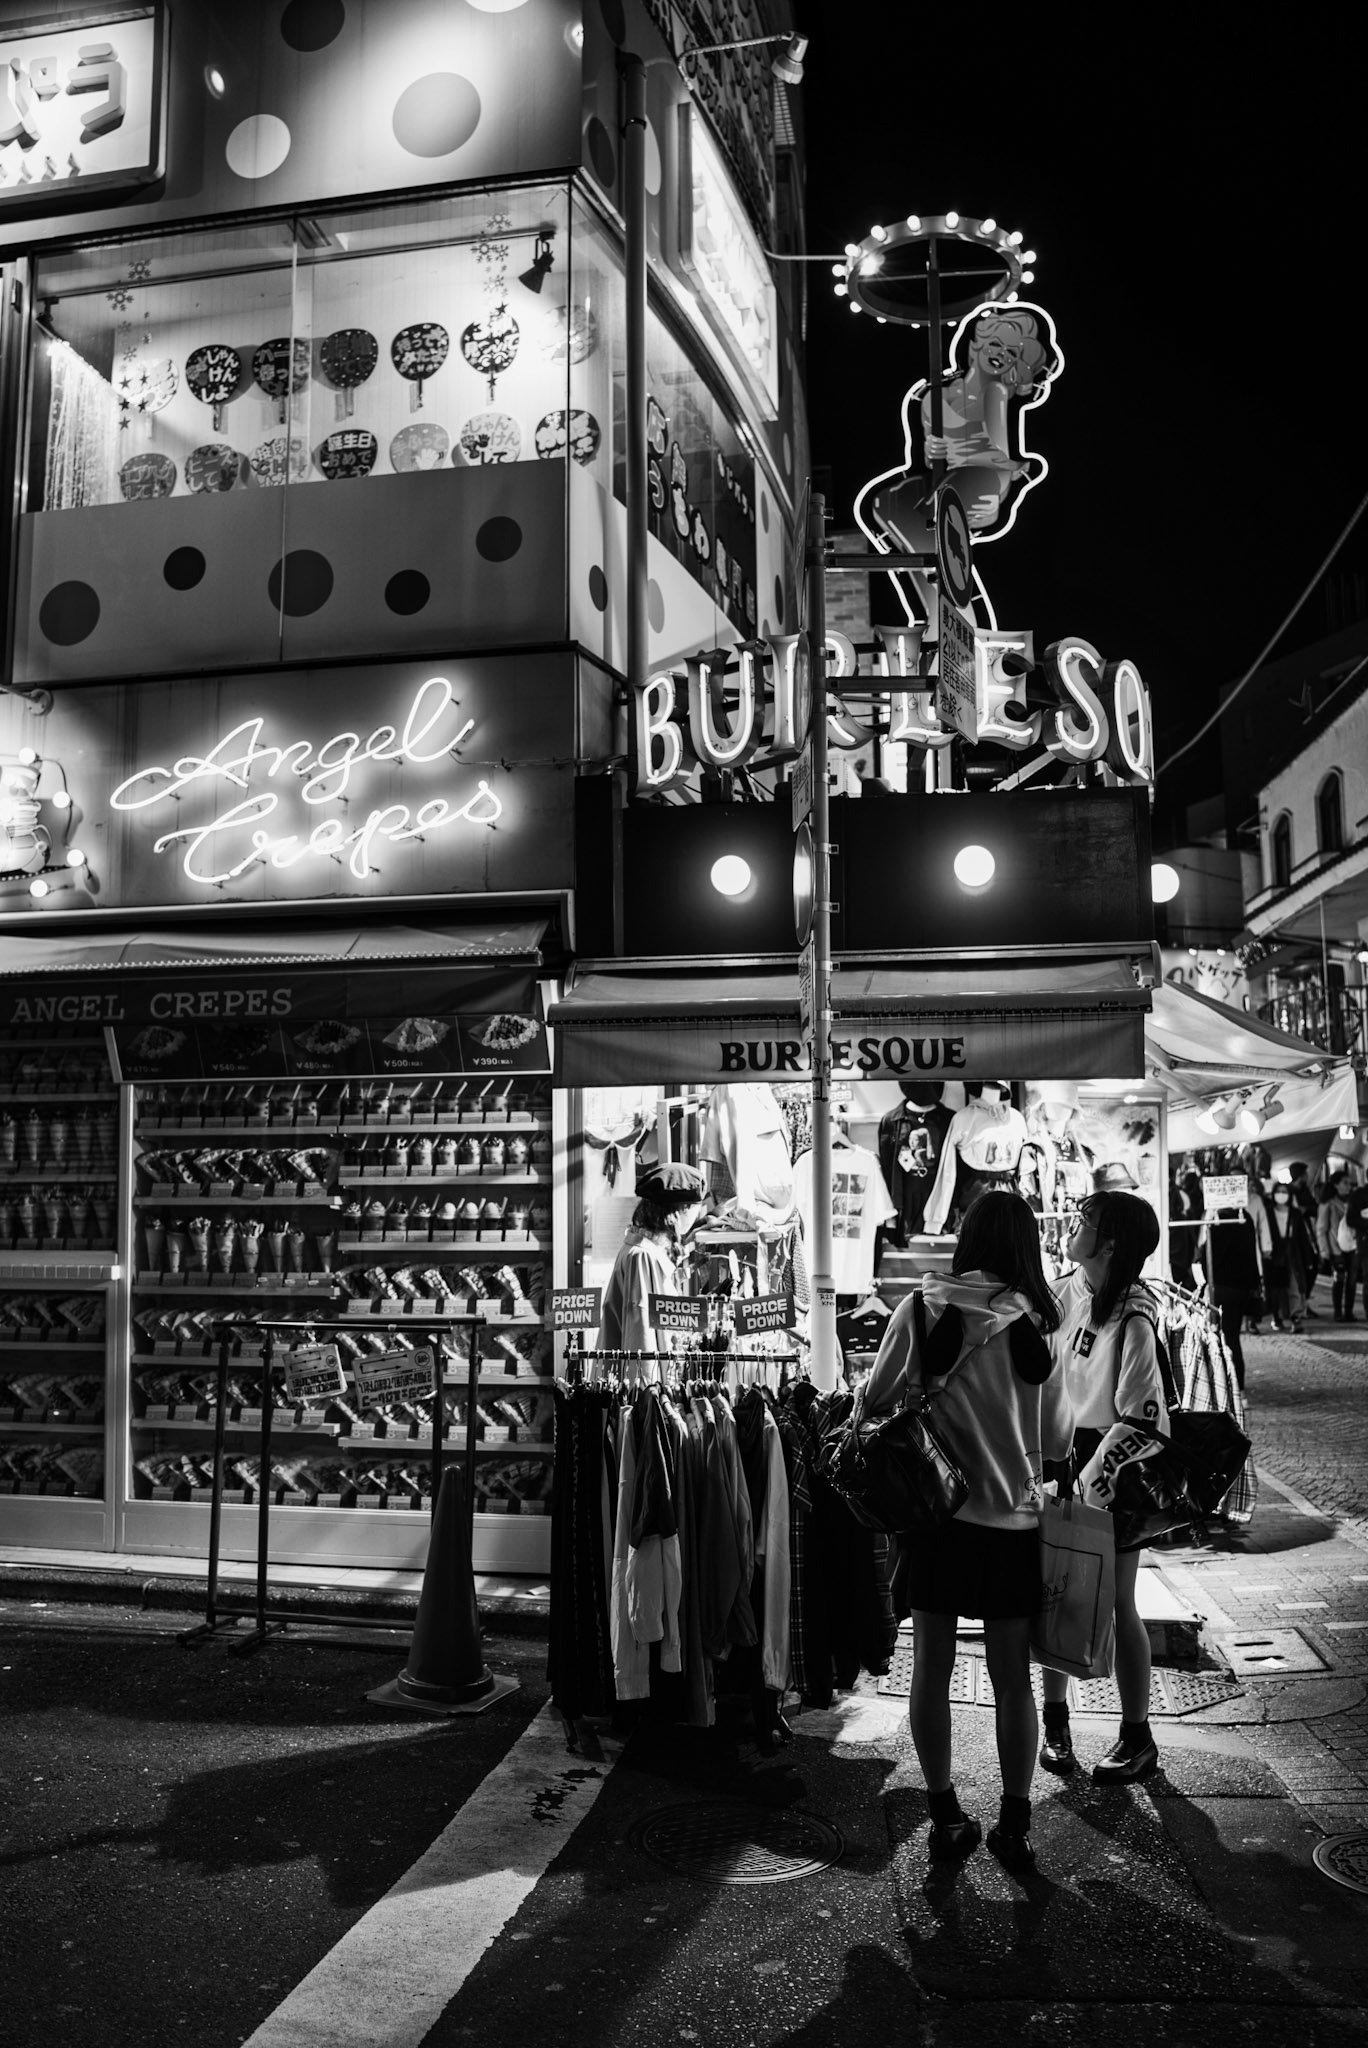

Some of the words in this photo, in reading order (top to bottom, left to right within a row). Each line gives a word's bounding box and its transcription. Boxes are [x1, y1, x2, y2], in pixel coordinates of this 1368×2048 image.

[111, 677, 475, 810] Angel
[153, 780, 502, 883] Crepes
[10, 995, 125, 1023] ANGEL
[149, 988, 293, 1018] CREPES
[552, 1294, 595, 1309] PRICE
[655, 1300, 701, 1315] PRICE
[742, 1298, 788, 1318] PRICE
[554, 1310, 592, 1324] DOWN
[659, 1314, 699, 1328] DOWN
[746, 1313, 787, 1330] DOWN
[1090, 1399, 1159, 1498] GNERAE
